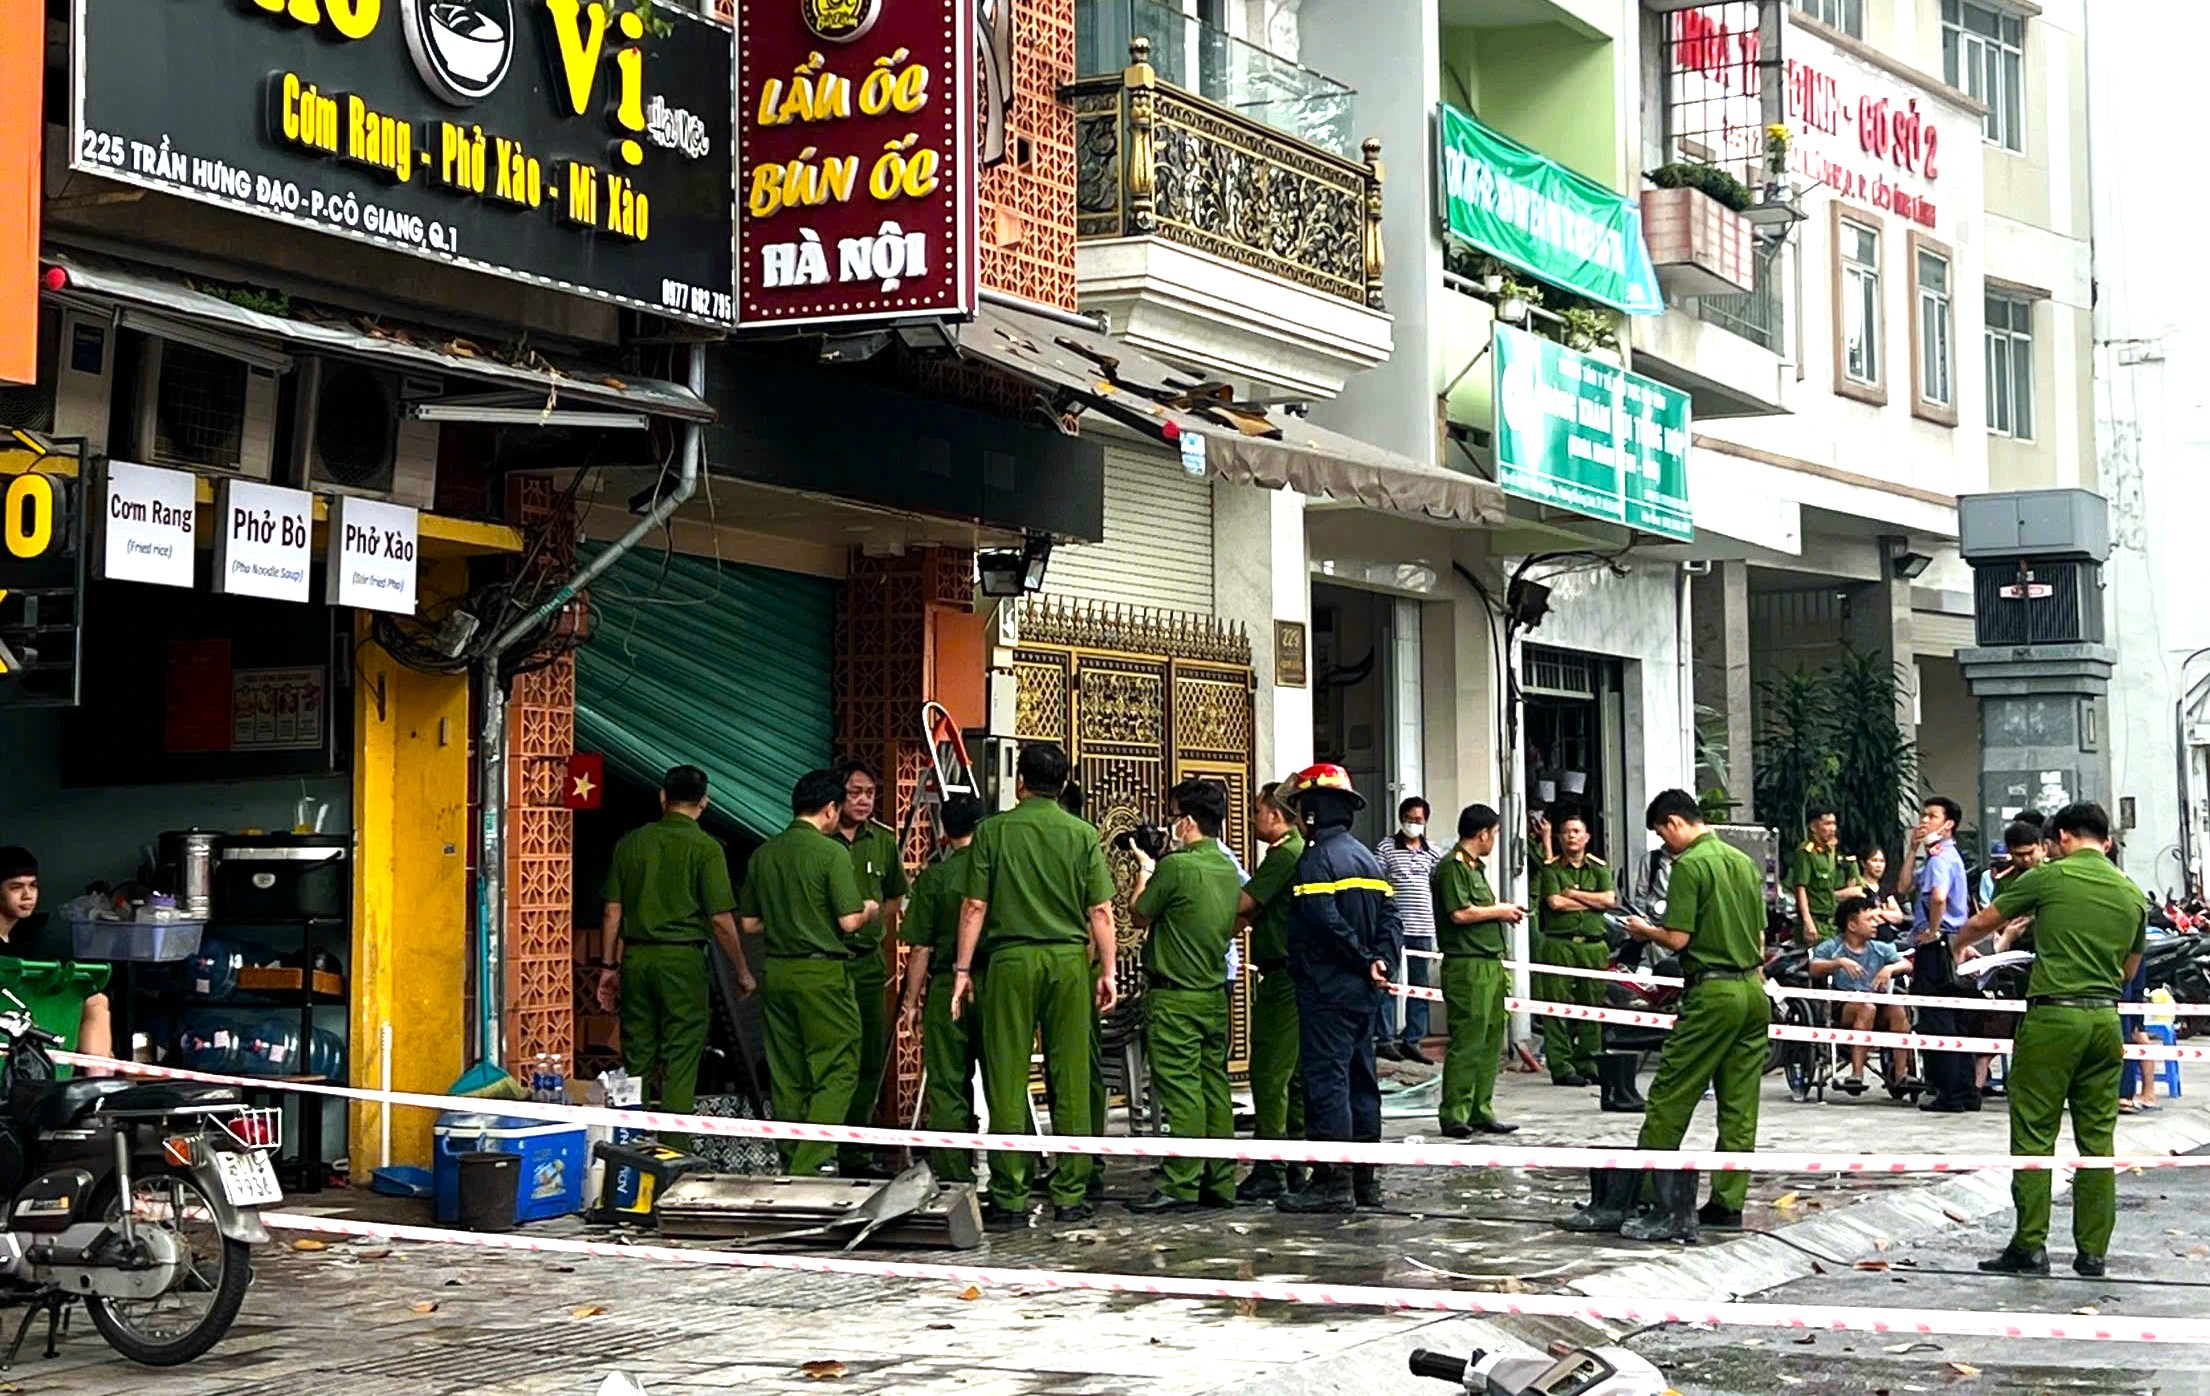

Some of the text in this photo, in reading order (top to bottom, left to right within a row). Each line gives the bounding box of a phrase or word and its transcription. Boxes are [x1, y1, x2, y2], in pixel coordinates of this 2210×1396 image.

[546, 0, 645, 166] Vị
[757, 47, 929, 125] LẨU ỐC
[84, 129, 124, 167] 225
[131, 134, 186, 183] TRẦN
[193, 159, 251, 199] HƯNG
[283, 73, 338, 151] Cơm
[349, 95, 411, 182] Rang
[442, 121, 486, 193] Phở
[496, 137, 541, 207] Xào
[569, 162, 597, 225] Mì
[608, 174, 648, 241] Xào
[750, 133, 940, 217] BÚN ỐC
[761, 220, 928, 292] HÀ NỘI
[111, 493, 192, 533] Cơm Rang
[233, 507, 307, 549] Phở Bò
[346, 523, 414, 562] Phở Xào
